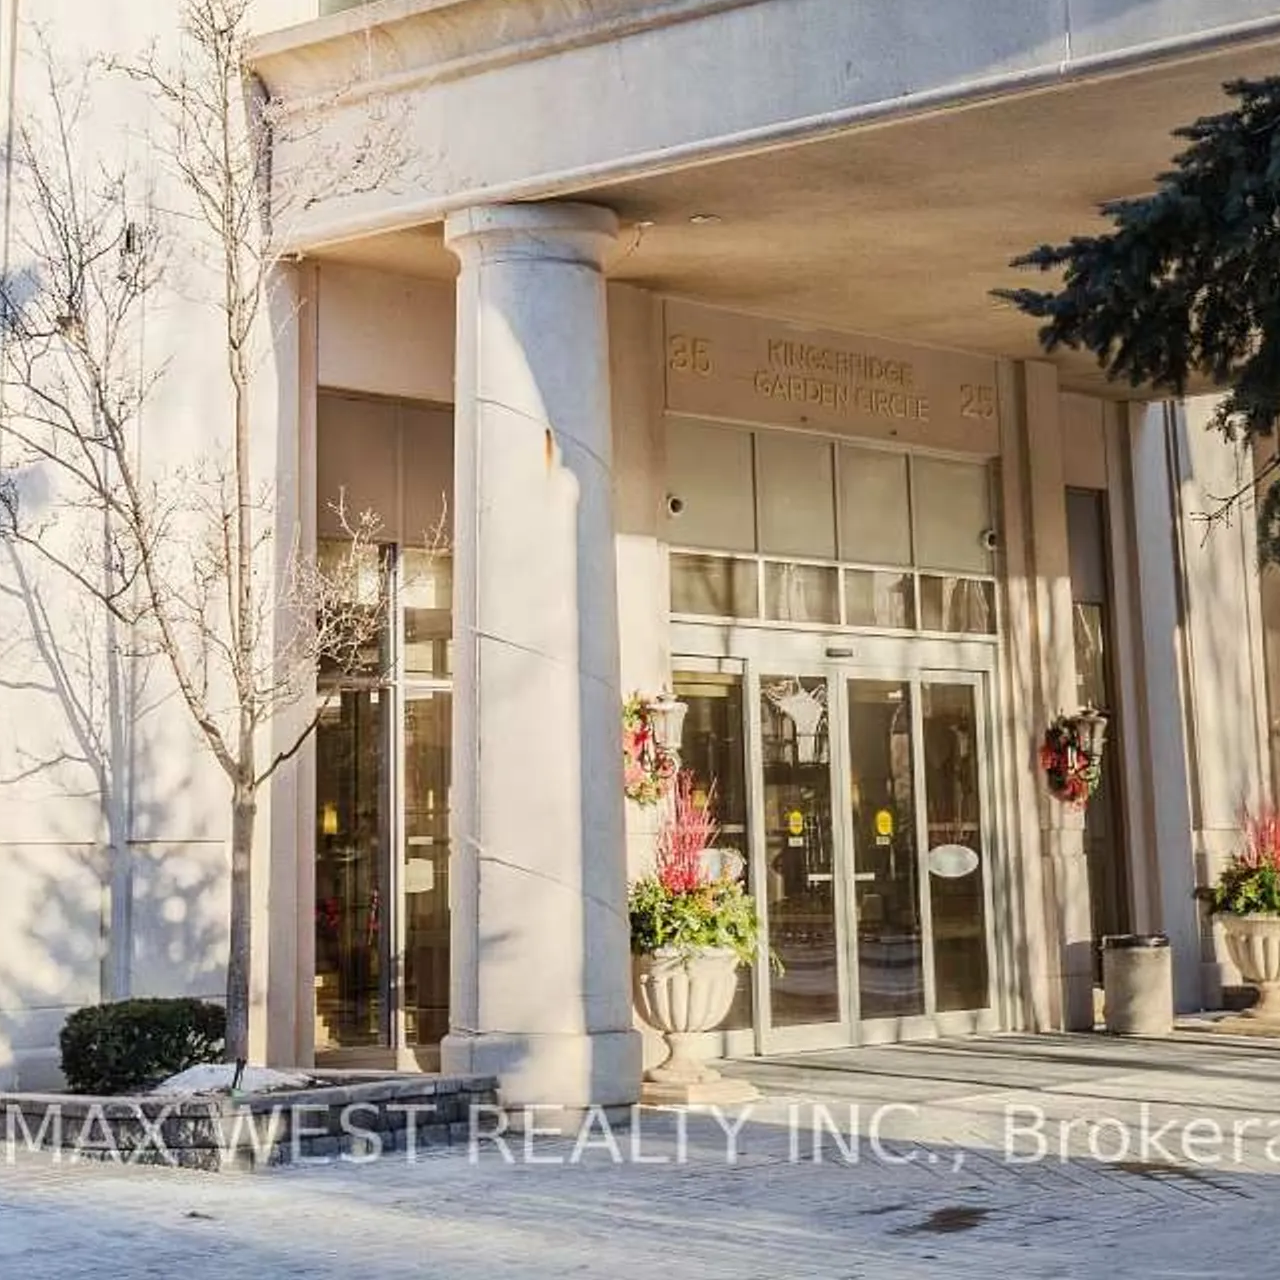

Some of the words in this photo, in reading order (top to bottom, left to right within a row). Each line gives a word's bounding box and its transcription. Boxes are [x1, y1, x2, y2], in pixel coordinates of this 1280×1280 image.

[766, 338, 913, 387] KINGSBRIDGE
[753, 369, 848, 412] GARDEN
[854, 385, 929, 422] CIRCLE
[960, 383, 994, 419] 25
